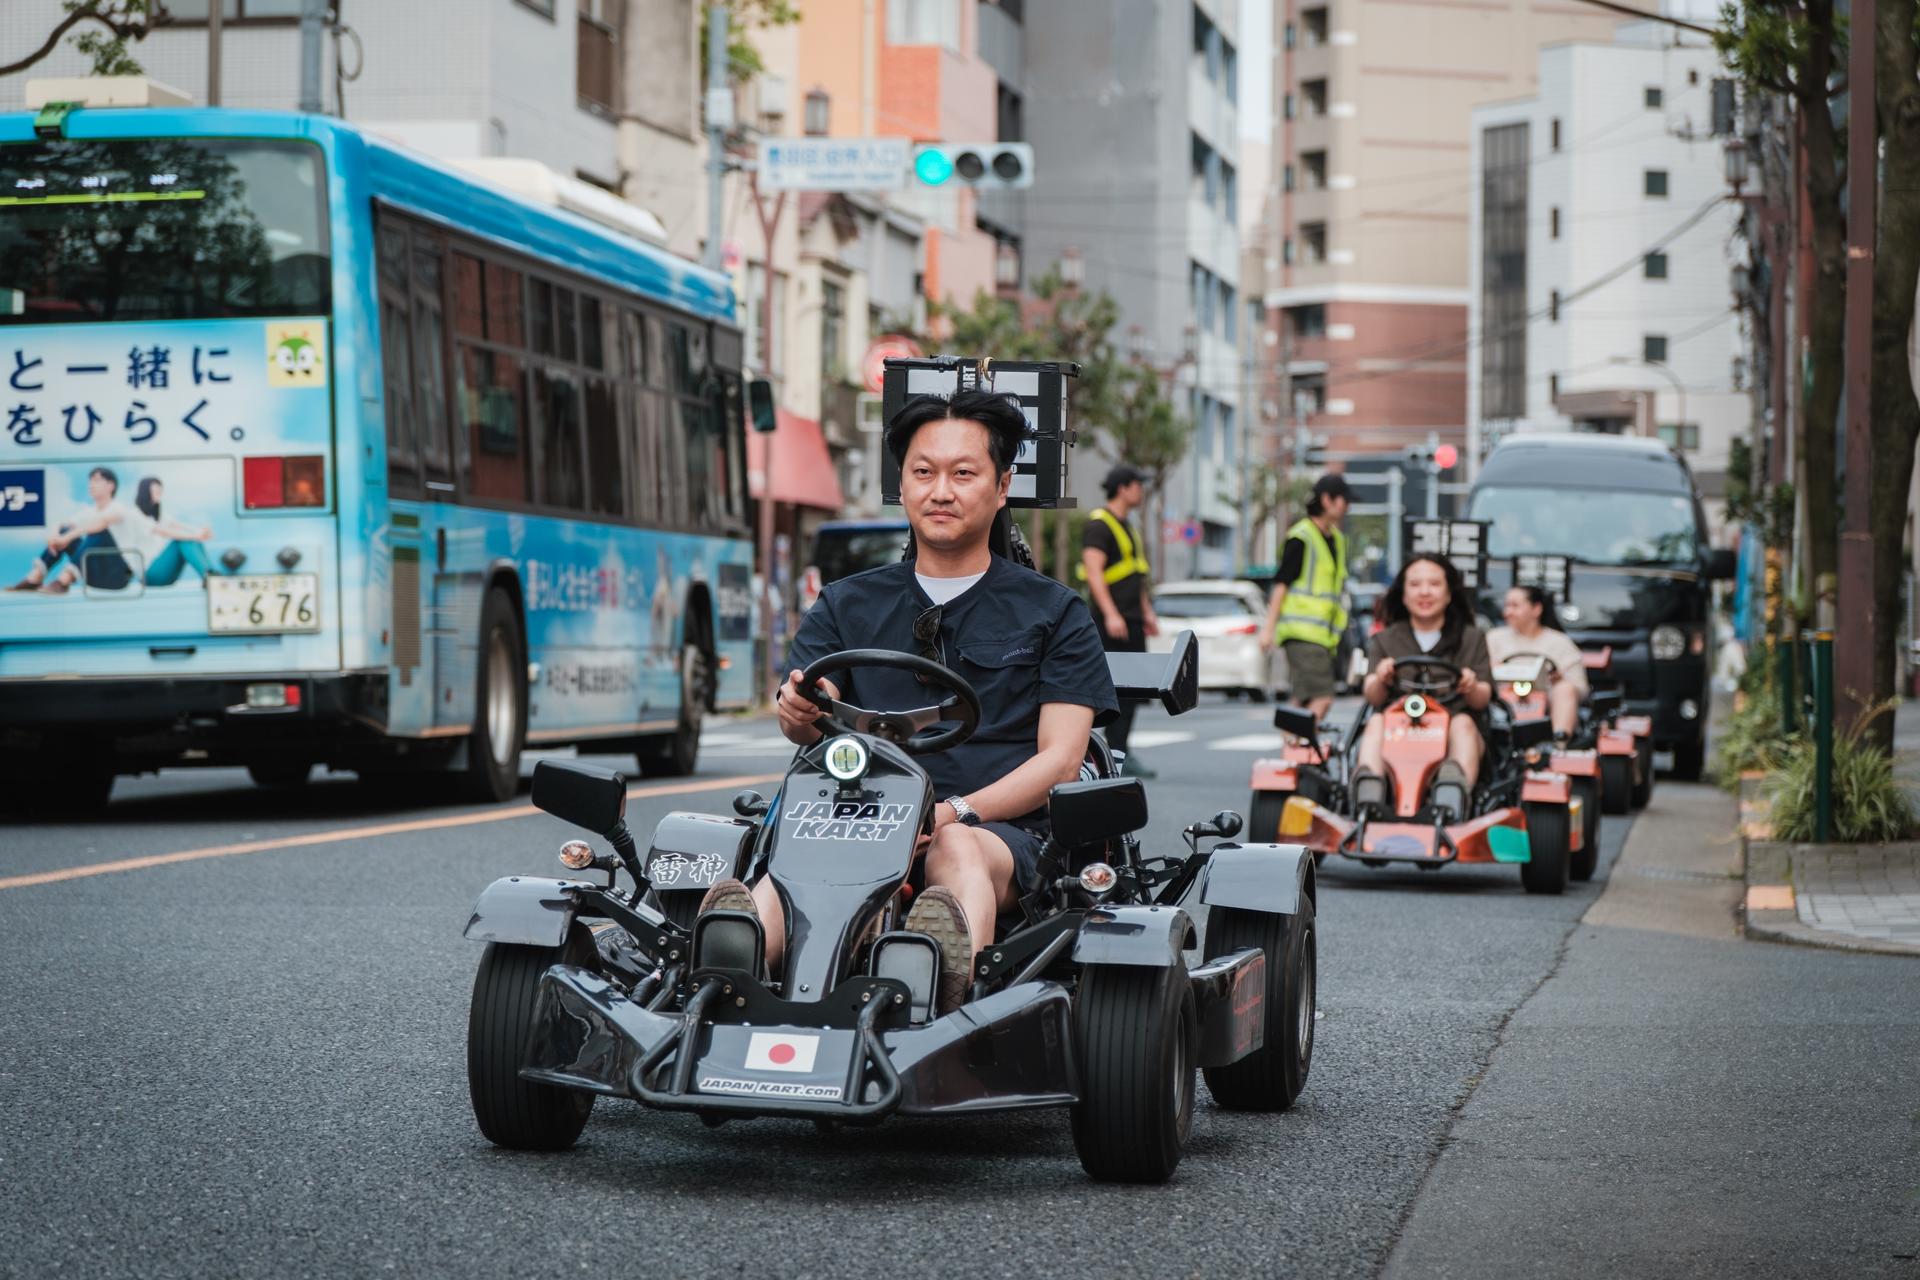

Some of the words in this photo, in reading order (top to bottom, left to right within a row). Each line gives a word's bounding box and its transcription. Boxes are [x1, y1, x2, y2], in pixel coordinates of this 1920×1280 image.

[9, 346, 232, 390] と一緒に
[962, 366, 976, 393] ART
[7, 400, 245, 446] をひらく。
[0, 485, 39, 511] ター
[784, 801, 914, 823] JAPAN
[792, 820, 901, 841] KART
[650, 853, 728, 885] 雷神
[702, 1079, 755, 1091] JAPAN
[759, 1083, 840, 1097] KART.com
